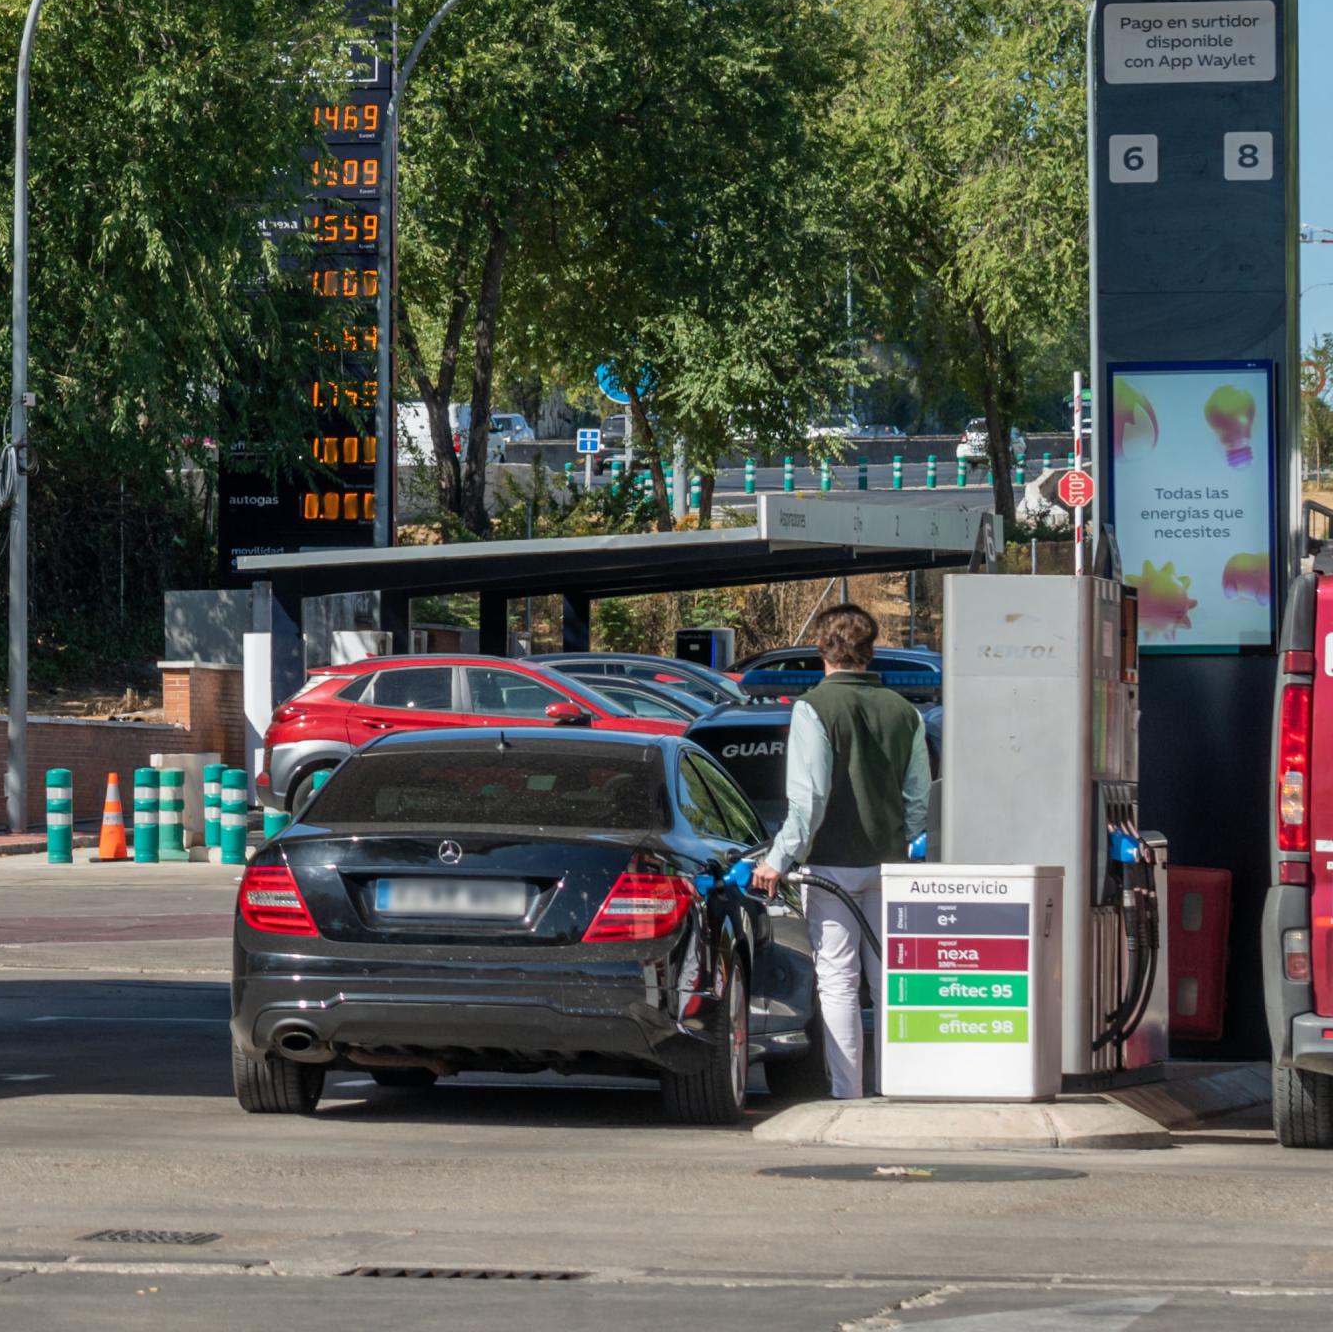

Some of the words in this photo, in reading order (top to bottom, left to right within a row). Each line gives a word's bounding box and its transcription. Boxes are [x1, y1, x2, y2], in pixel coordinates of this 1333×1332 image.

[1120, 16, 1163, 32] Pago
[1167, 17, 1187, 29] en
[1191, 14, 1259, 28] surtidor
[1145, 34, 1233, 51] disponible
[1124, 56, 1154, 68] con
[1158, 55, 1193, 70] App
[1197, 53, 1256, 69] Waylet
[1123, 145, 1145, 171] 6
[1237, 143, 1259, 169] 8
[1068, 473, 1085, 504] STOP
[1154, 487, 1202, 500] Todas
[1205, 486, 1230, 499] las
[229, 495, 279, 507] autogas
[1140, 506, 1210, 522] energías
[1213, 508, 1244, 521] que
[1154, 525, 1231, 538] necesites
[722, 741, 785, 758] GUAR
[910, 880, 1009, 895] Autoservicio
[937, 913, 958, 926] e+
[937, 948, 980, 961] nexa
[938, 983, 988, 998] efitec
[991, 984, 1013, 998] 95
[938, 1019, 988, 1034] efitec
[991, 1020, 1014, 1034] 98
